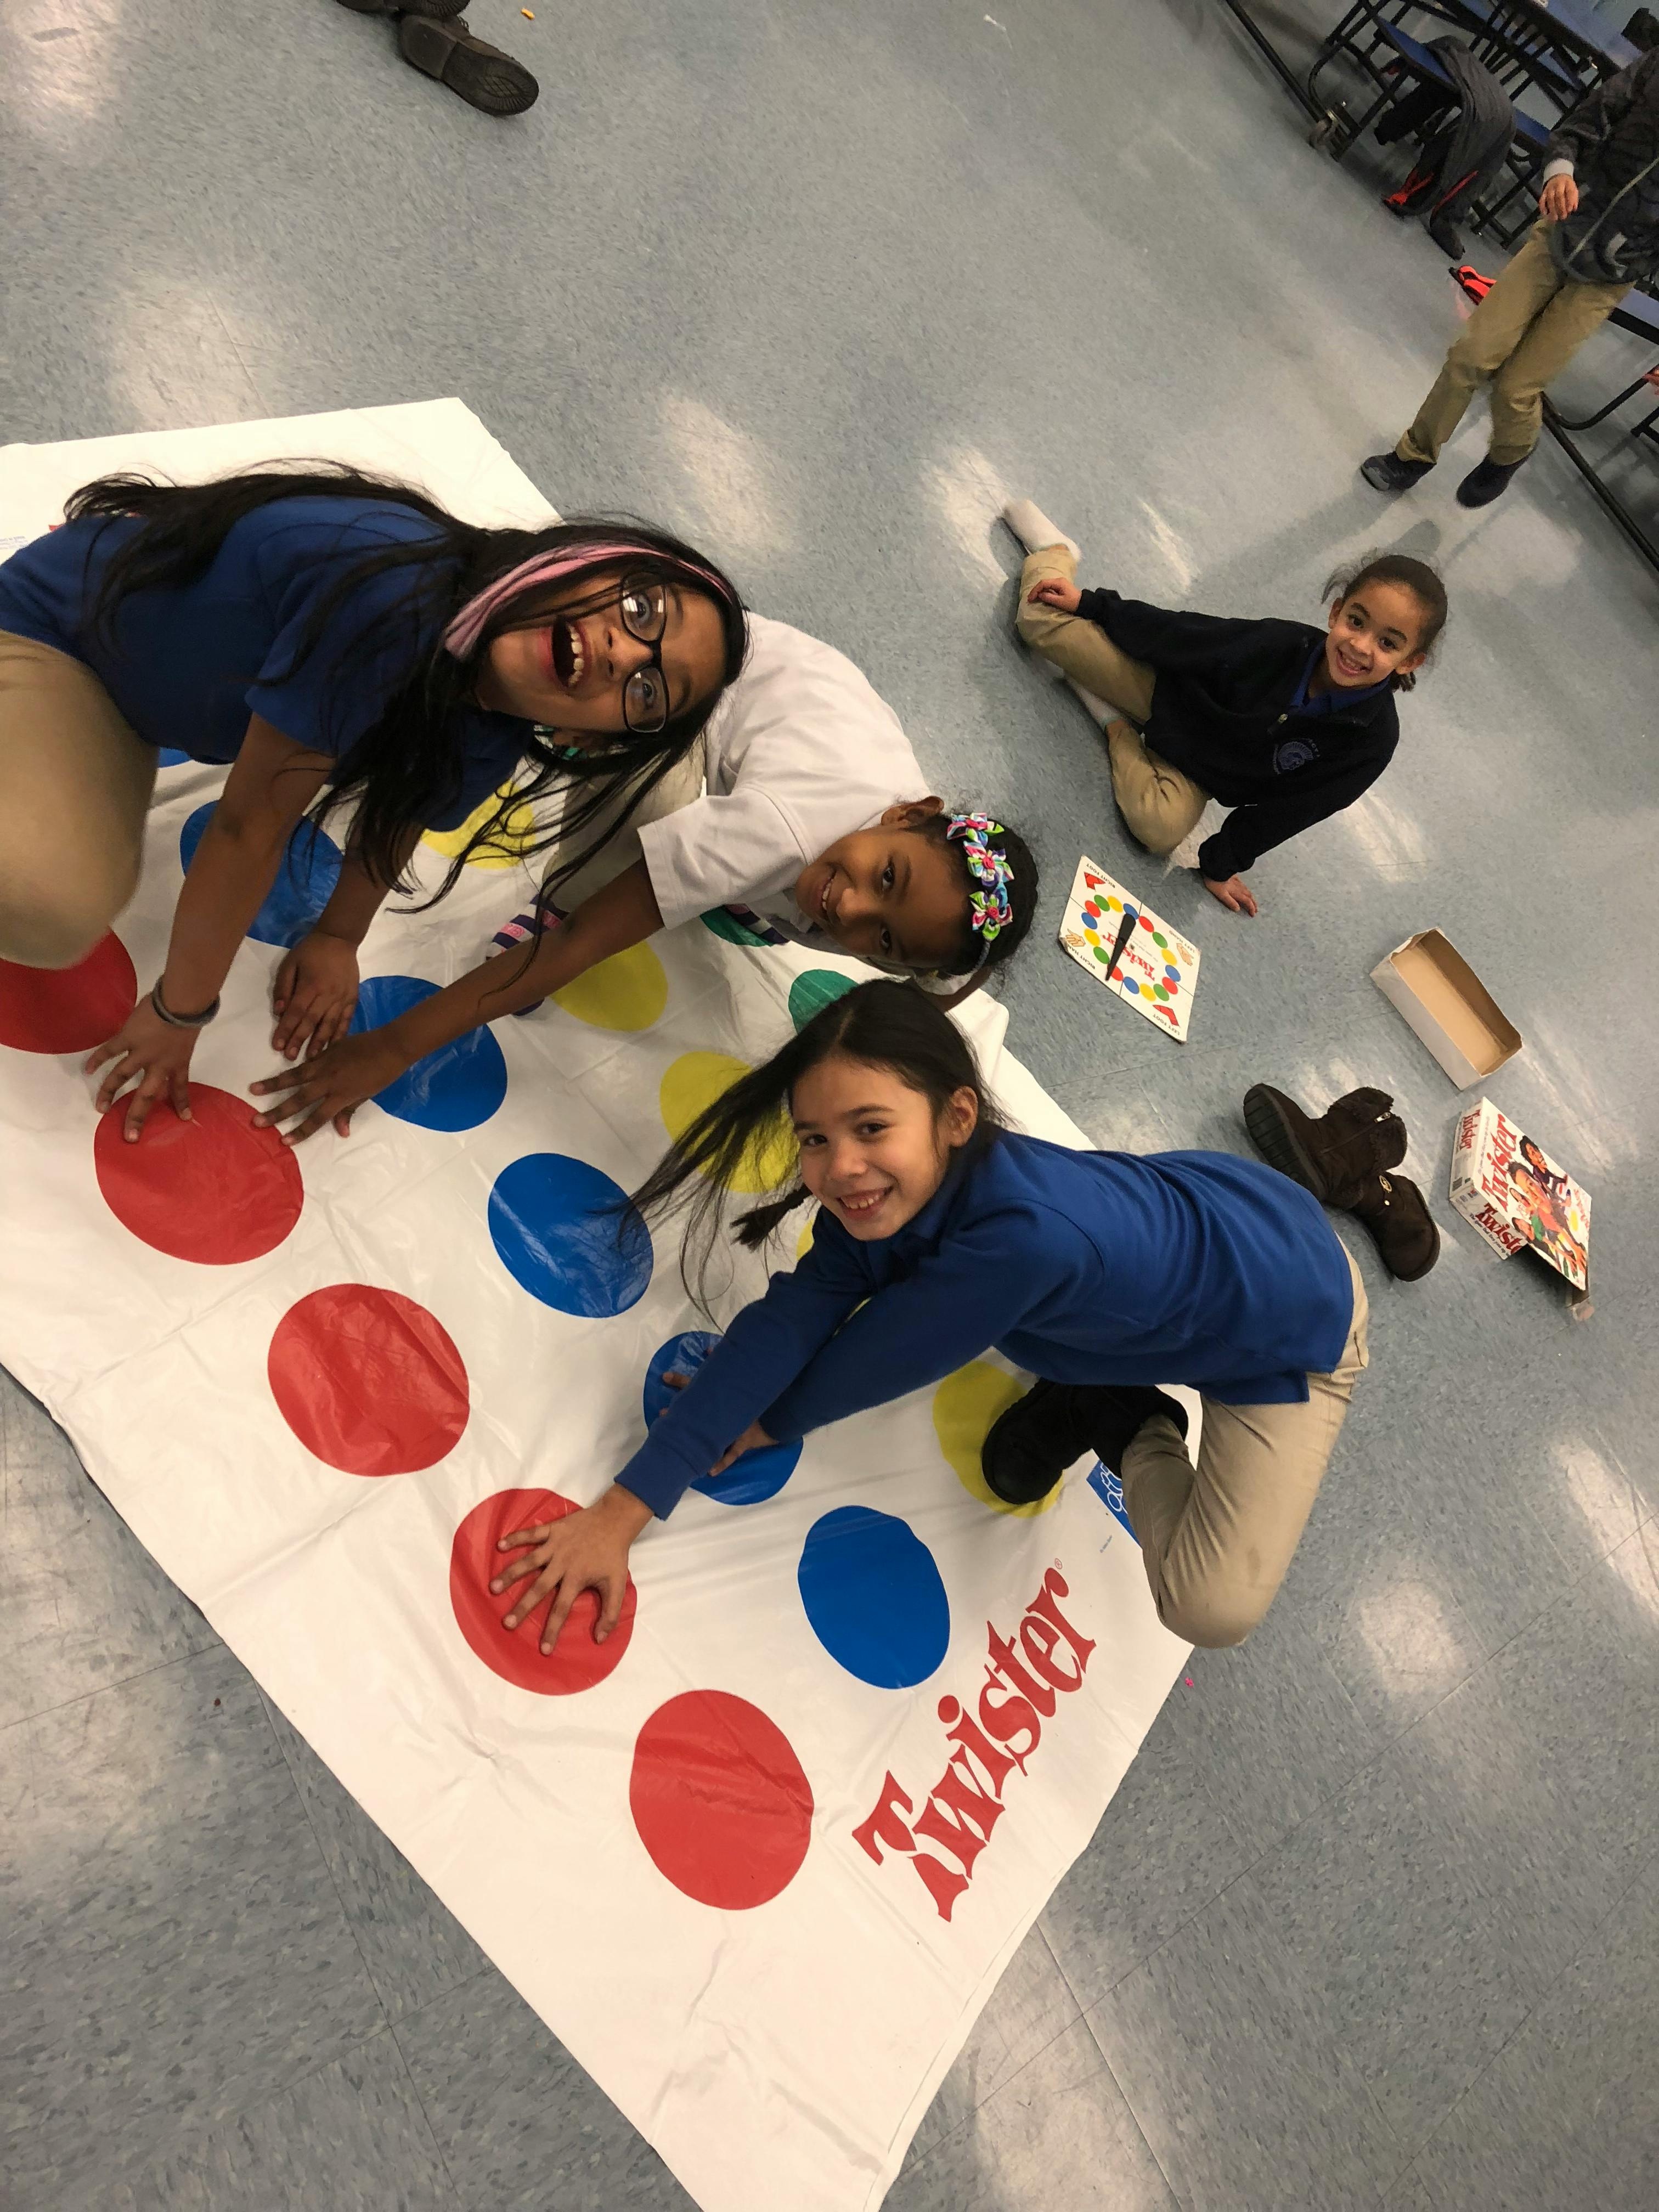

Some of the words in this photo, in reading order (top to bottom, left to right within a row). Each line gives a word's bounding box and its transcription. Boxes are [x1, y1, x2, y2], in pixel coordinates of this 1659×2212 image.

[1086, 863, 1099, 876] FOOT
[1101, 874, 1115, 888] RIGHT
[1079, 955, 1096, 970] RIGHT
[1102, 932, 1155, 981] Twiser
[1153, 1013, 1167, 1026] FOOT
[1168, 1025, 1180, 1036] LEFT
[1459, 1108, 1481, 1150] Twister
[1481, 1113, 1517, 1212] Twister
[851, 1566, 1097, 1923] Twister
